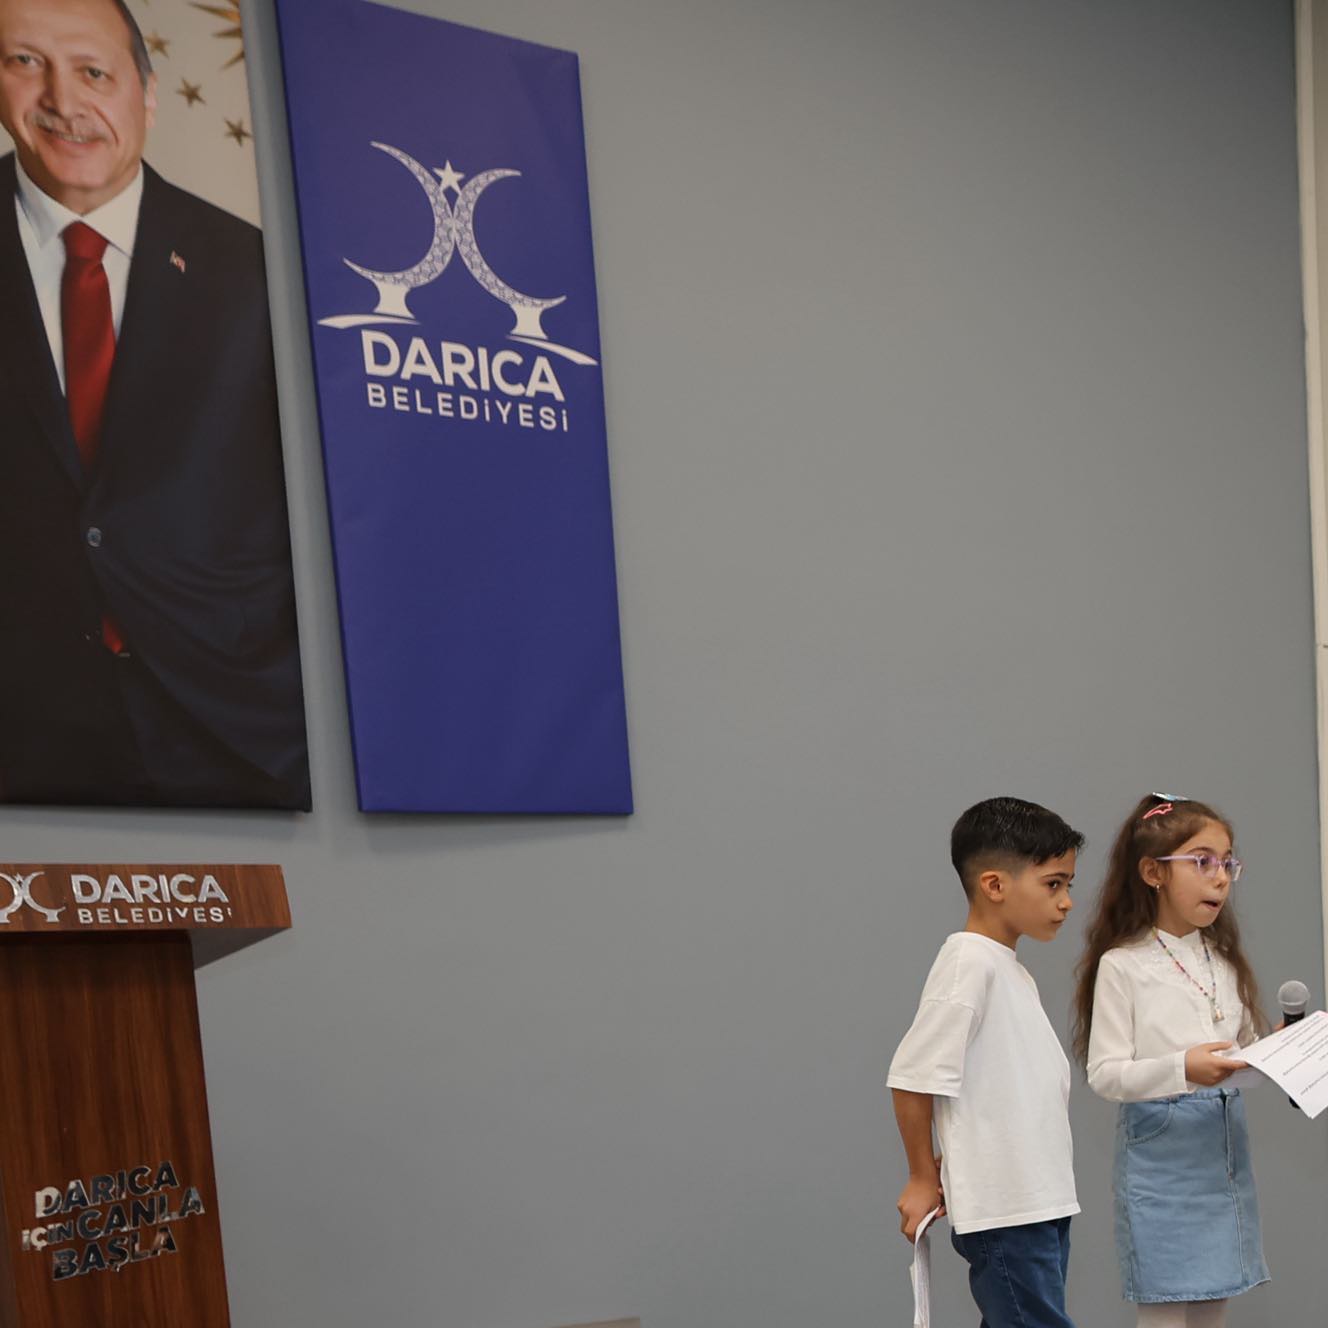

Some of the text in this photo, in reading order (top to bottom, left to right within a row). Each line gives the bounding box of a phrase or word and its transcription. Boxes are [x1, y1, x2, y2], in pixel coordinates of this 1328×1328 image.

[361, 329, 566, 402] DARICA
[366, 383, 570, 432] BELEDİYESİ
[70, 873, 229, 904] DARICA
[35, 1160, 180, 1219] DARICA
[21, 1186, 206, 1252] İÇİN CANLA
[52, 1225, 178, 1281] BAŞLA
